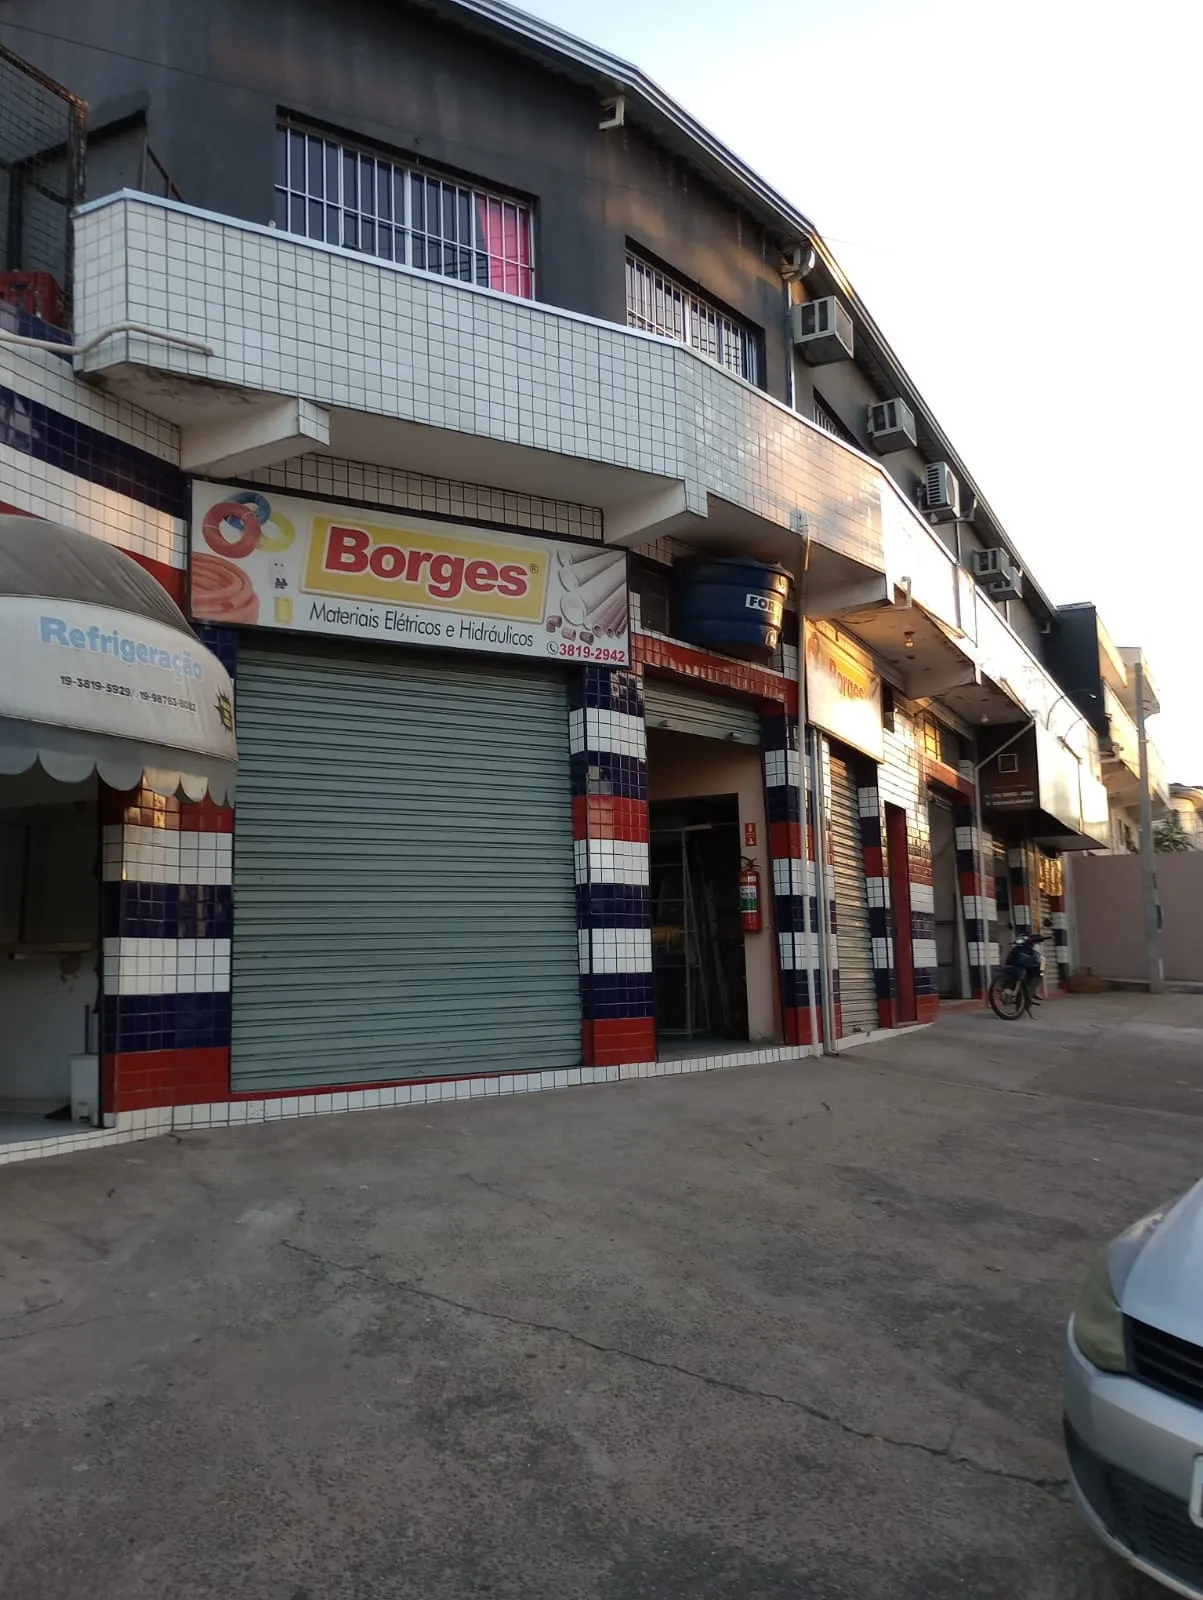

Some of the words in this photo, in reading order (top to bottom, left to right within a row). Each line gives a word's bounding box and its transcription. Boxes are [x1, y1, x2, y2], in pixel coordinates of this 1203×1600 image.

[324, 526, 528, 597] Borges
[309, 602, 380, 629] Materiais
[384, 610, 441, 637] Elétricos
[446, 625, 455, 638] e
[459, 620, 534, 648] Hidráulicos
[748, 595, 779, 613] FOR
[40, 616, 203, 682] Refrigeração
[558, 642, 626, 664] 3819-2942
